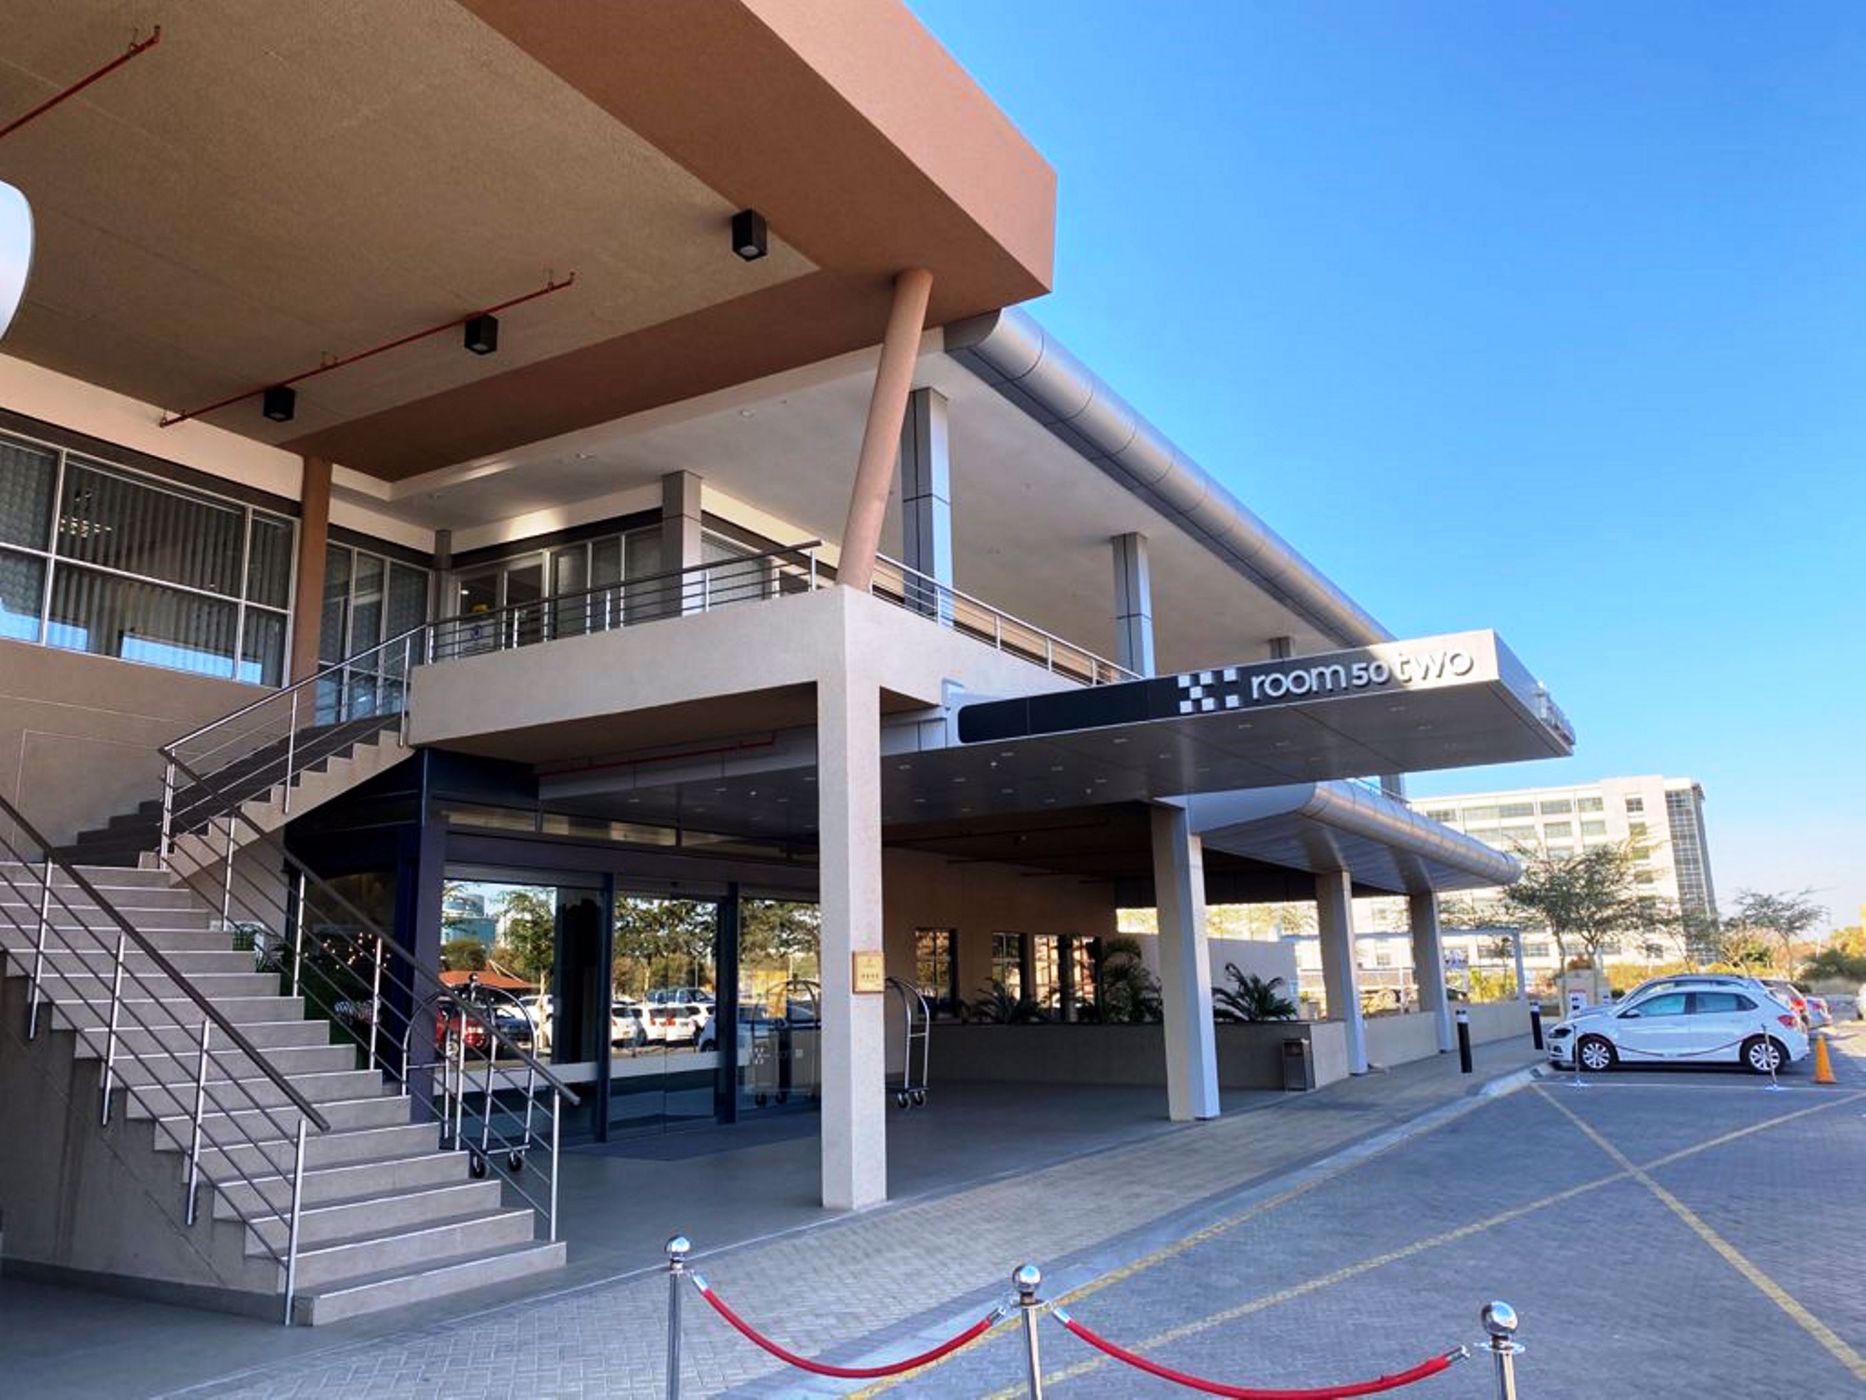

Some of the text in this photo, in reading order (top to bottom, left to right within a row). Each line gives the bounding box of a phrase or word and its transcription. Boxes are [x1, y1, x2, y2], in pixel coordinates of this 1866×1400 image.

[1252, 650, 1474, 699] room 50 two
